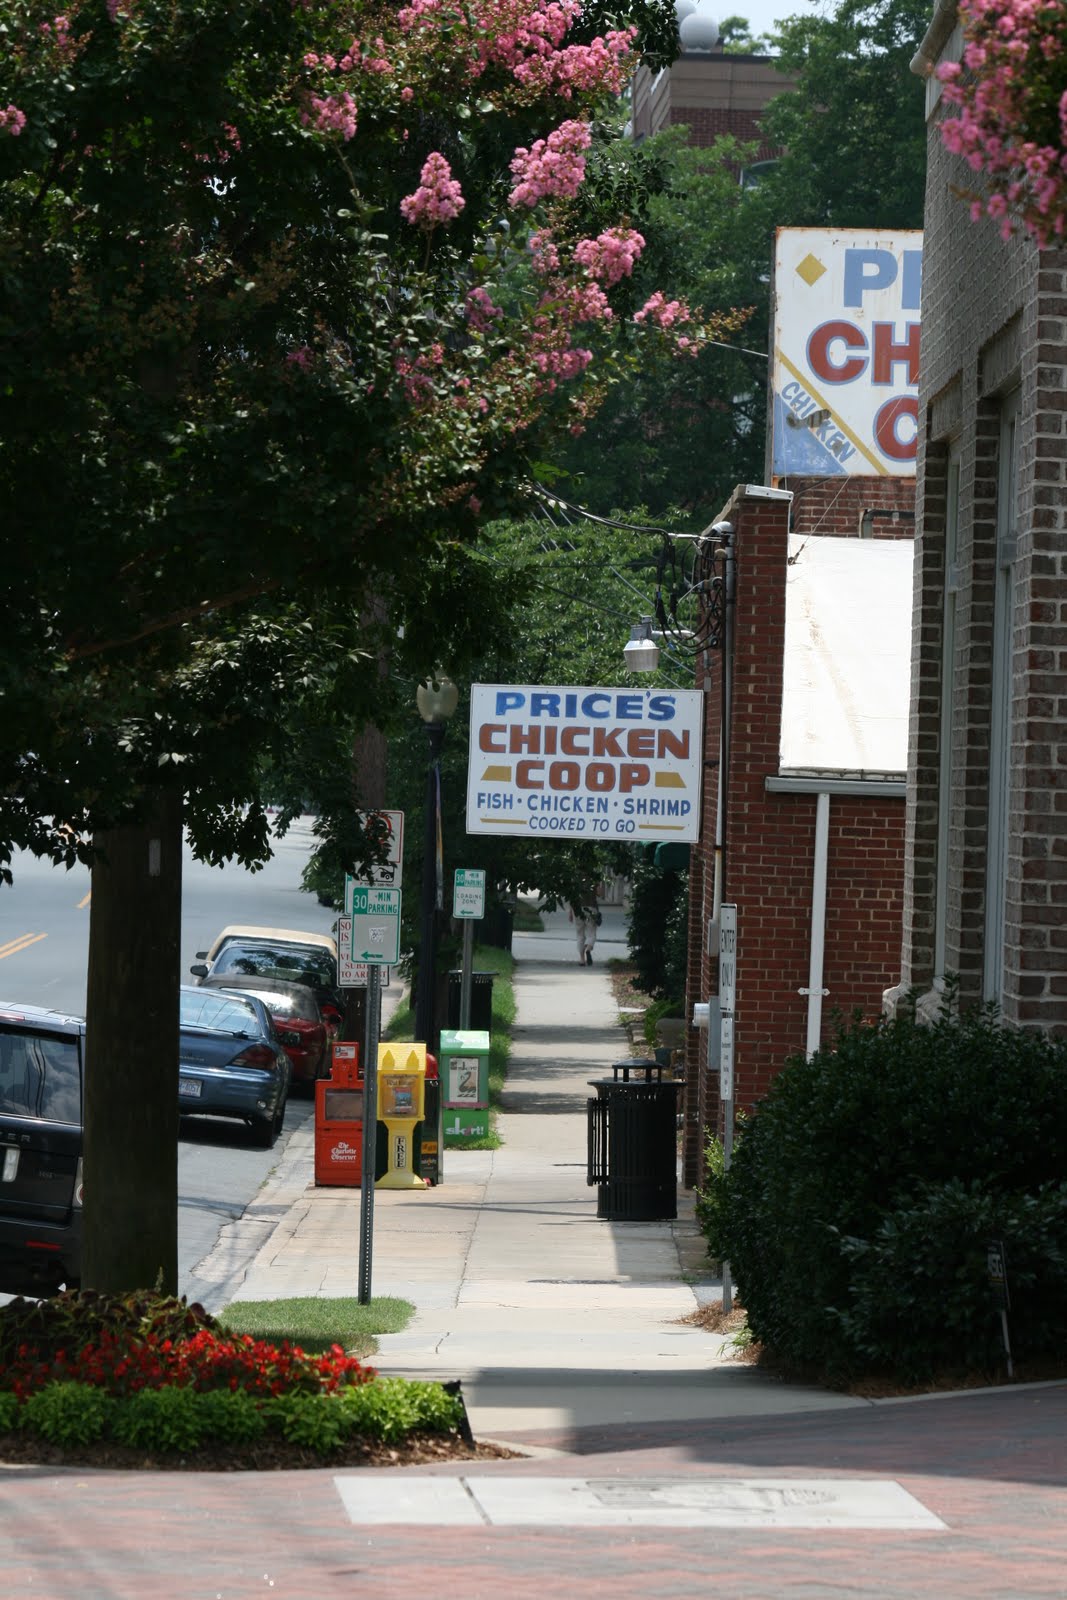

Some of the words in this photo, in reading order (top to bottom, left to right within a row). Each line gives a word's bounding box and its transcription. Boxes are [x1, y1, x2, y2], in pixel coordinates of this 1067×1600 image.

[806, 319, 920, 386] CH
[781, 382, 856, 463] CHIKEN
[495, 691, 676, 721] PRICE'S
[479, 723, 690, 759] CHICKEN
[515, 760, 650, 793] COOP
[477, 793, 514, 810] FISH
[527, 794, 609, 814] CHICKEN
[623, 798, 691, 817] SHRIMP
[529, 815, 586, 831] COOKED
[593, 818, 611, 833] TO
[615, 819, 636, 833] GO
[354, 894, 367, 909] 30
[368, 904, 398, 914] PARKING
[341, 932, 349, 941] IS
[338, 1141, 349, 1149] The
[396, 1137, 405, 1168] FREE
